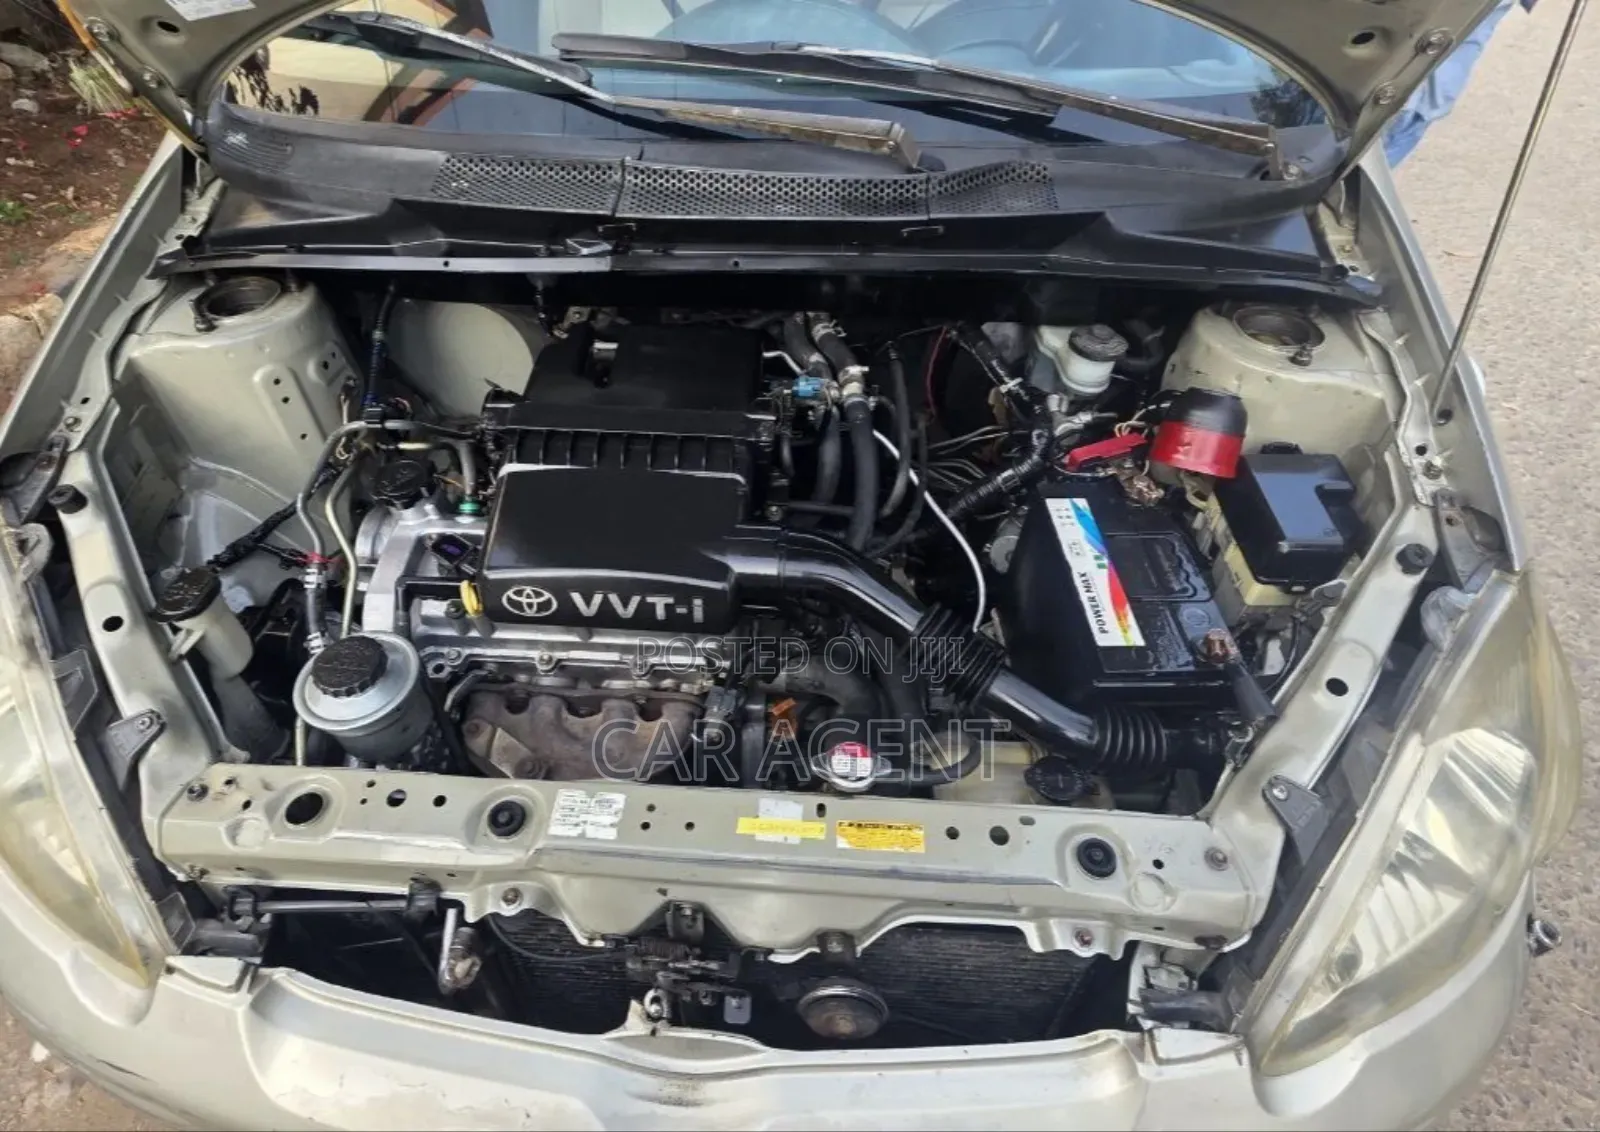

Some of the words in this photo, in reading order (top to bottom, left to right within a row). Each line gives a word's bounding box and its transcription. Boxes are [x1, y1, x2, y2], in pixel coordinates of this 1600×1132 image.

[1077, 571, 1093, 594] MAX
[570, 591, 704, 623] VVT-i
[1087, 595, 1108, 634] POWER
